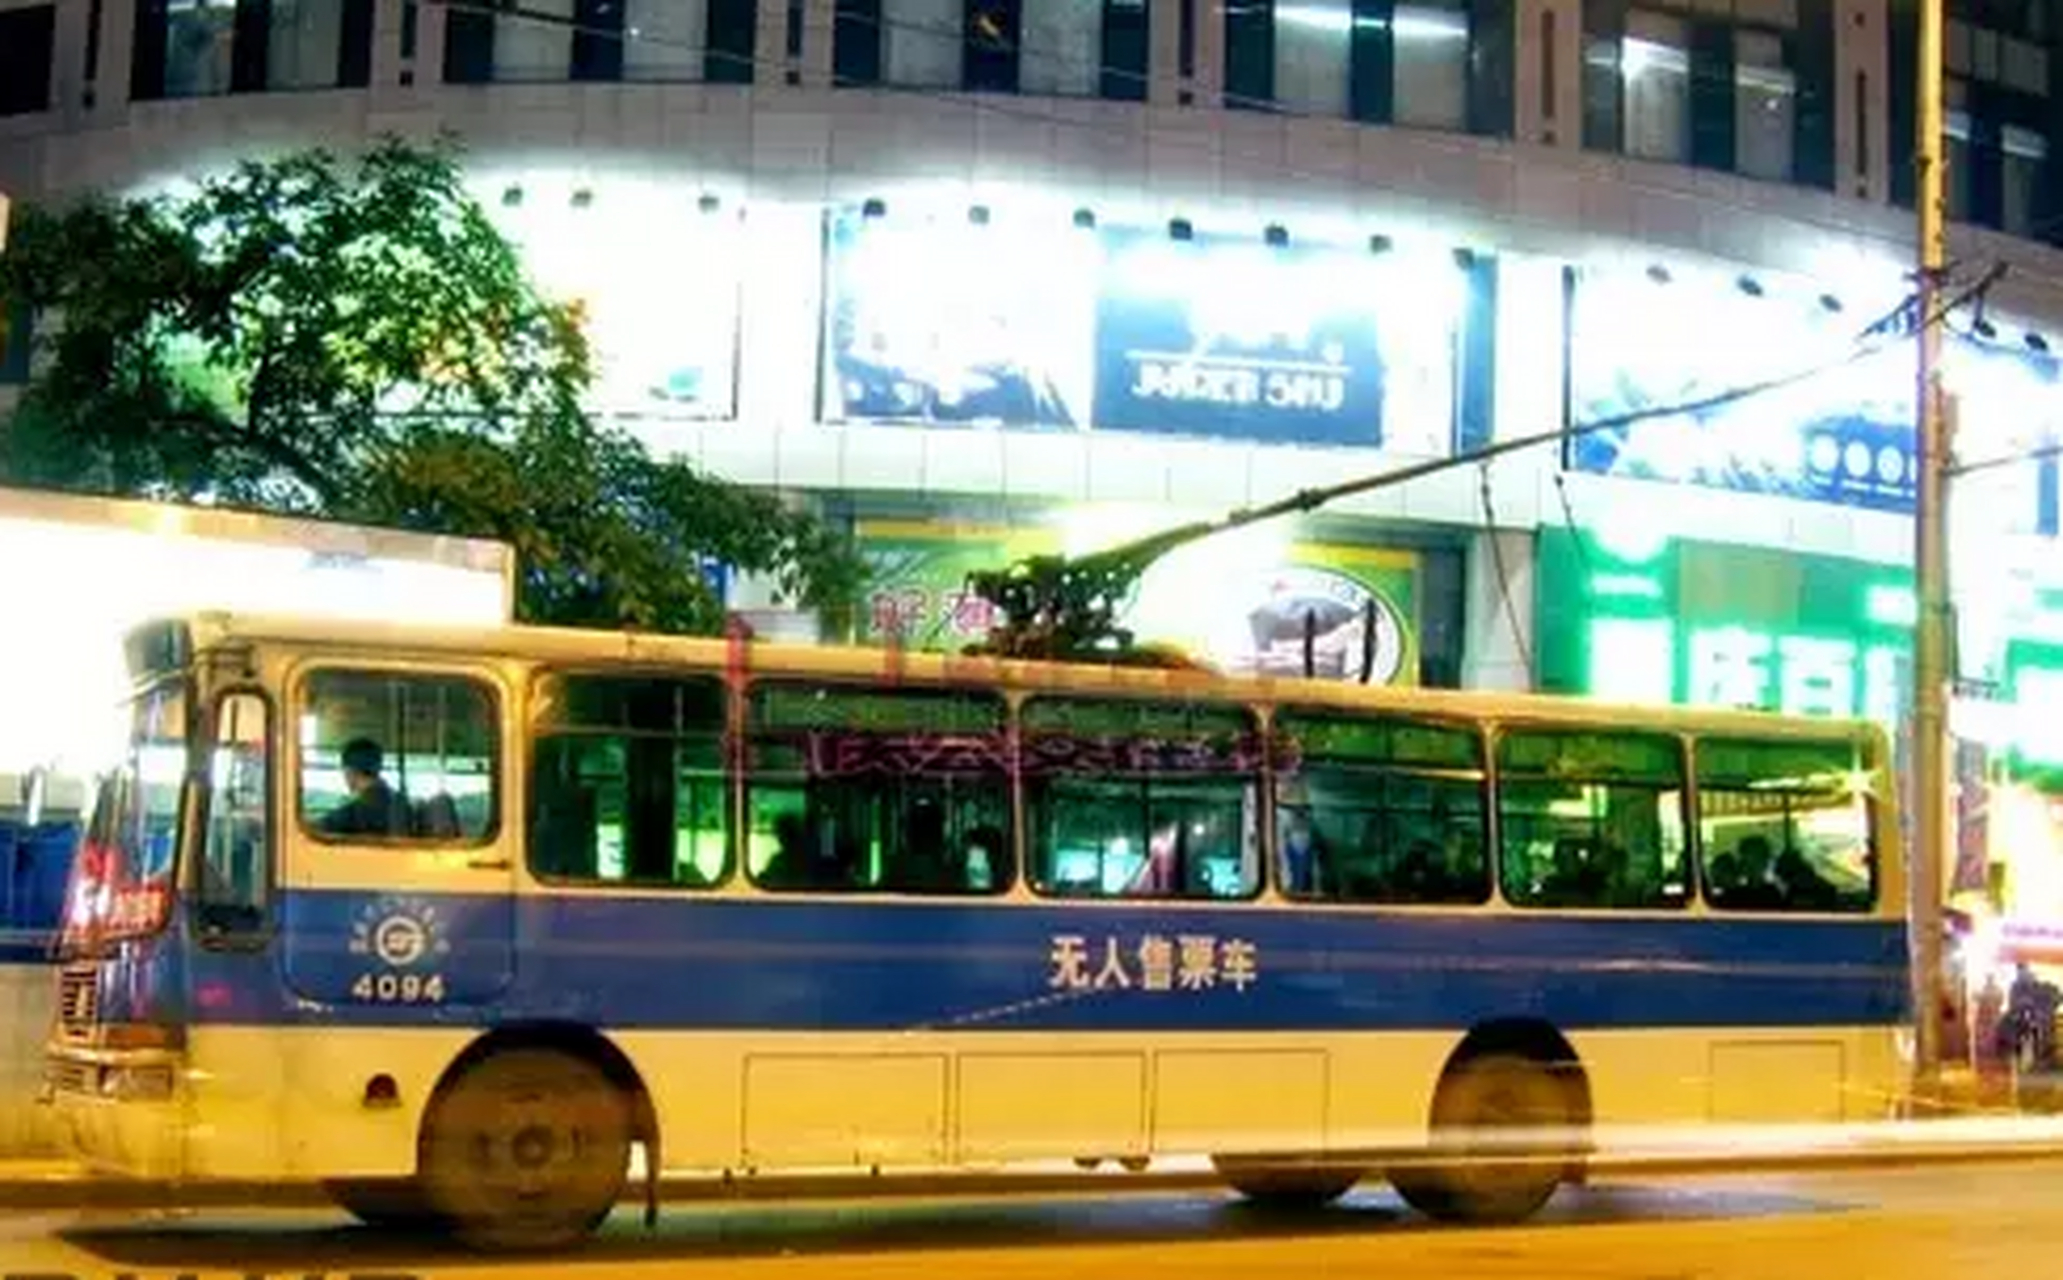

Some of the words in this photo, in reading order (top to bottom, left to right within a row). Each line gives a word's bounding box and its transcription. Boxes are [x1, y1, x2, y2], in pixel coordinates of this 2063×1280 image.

[1049, 932, 1257, 991] 无人售票车
[352, 972, 444, 1001] 4094
